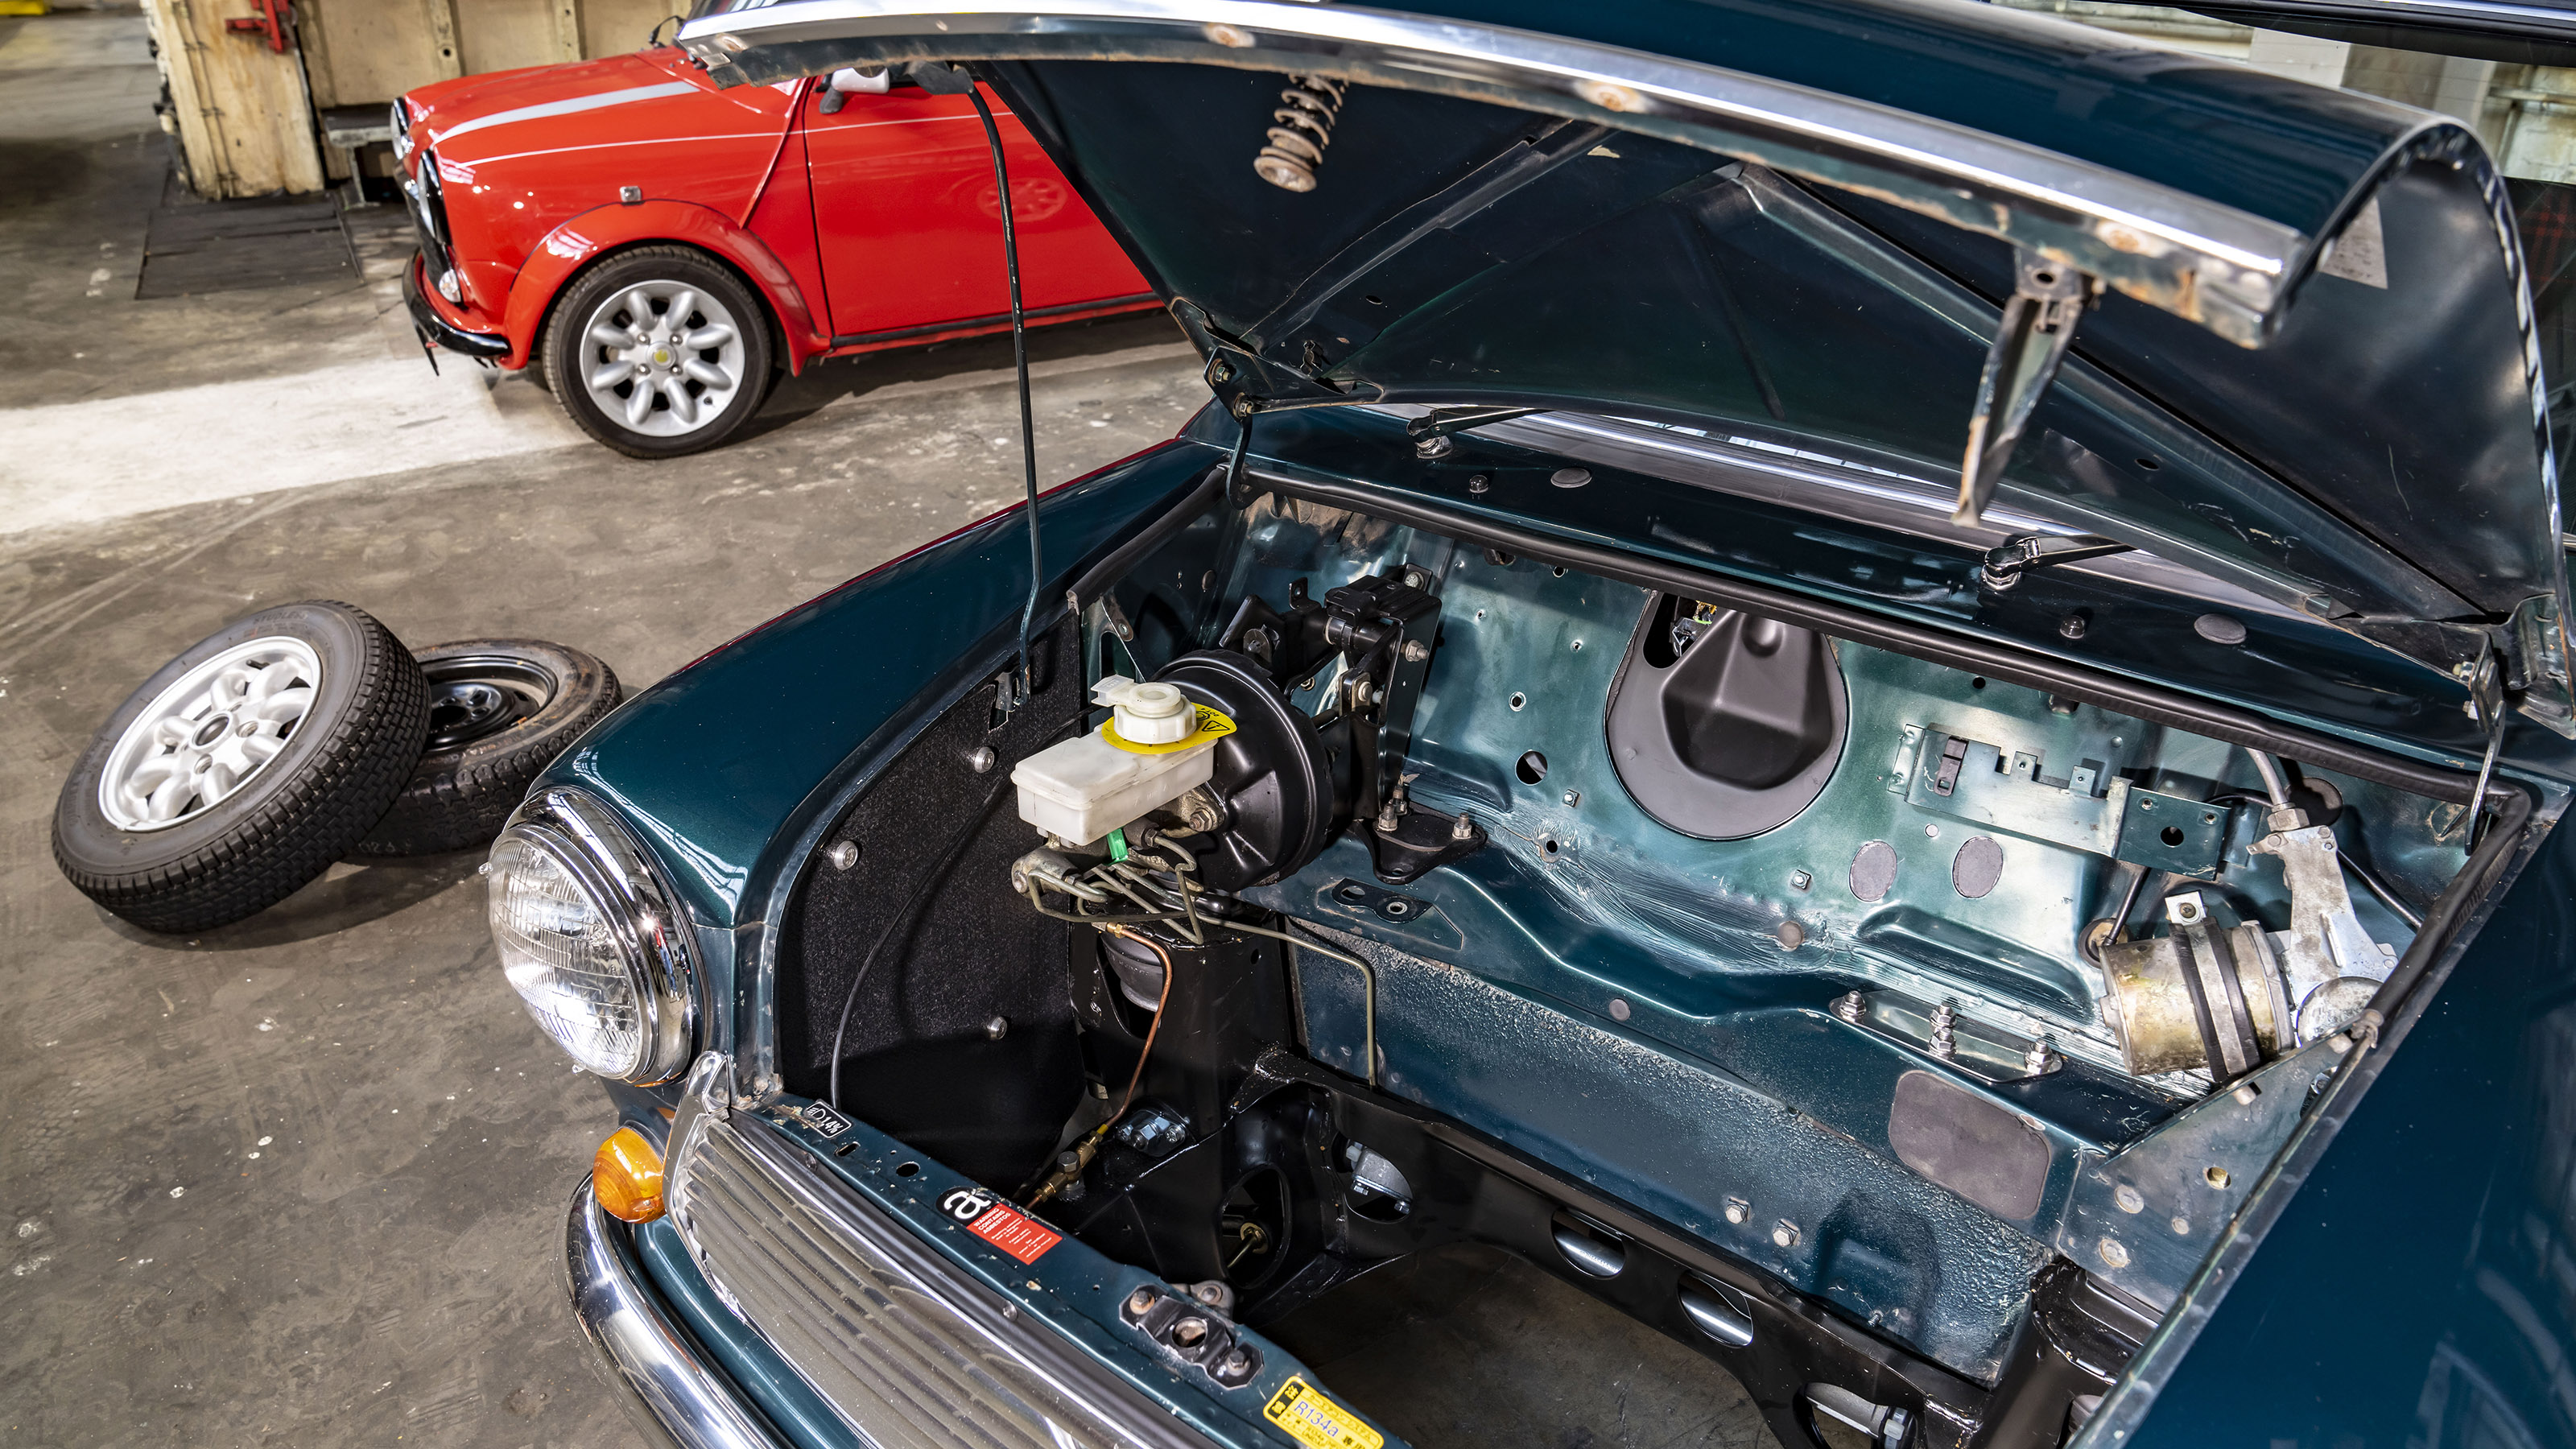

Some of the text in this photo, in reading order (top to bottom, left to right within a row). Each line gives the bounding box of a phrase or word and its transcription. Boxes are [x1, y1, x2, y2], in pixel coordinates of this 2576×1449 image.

[973, 1208, 1000, 1227] WARNING
[978, 1210, 1005, 1230] CONTAINS
[983, 1212, 1011, 1234] ASBESTOS
[1294, 1400, 1340, 1437] R134a
